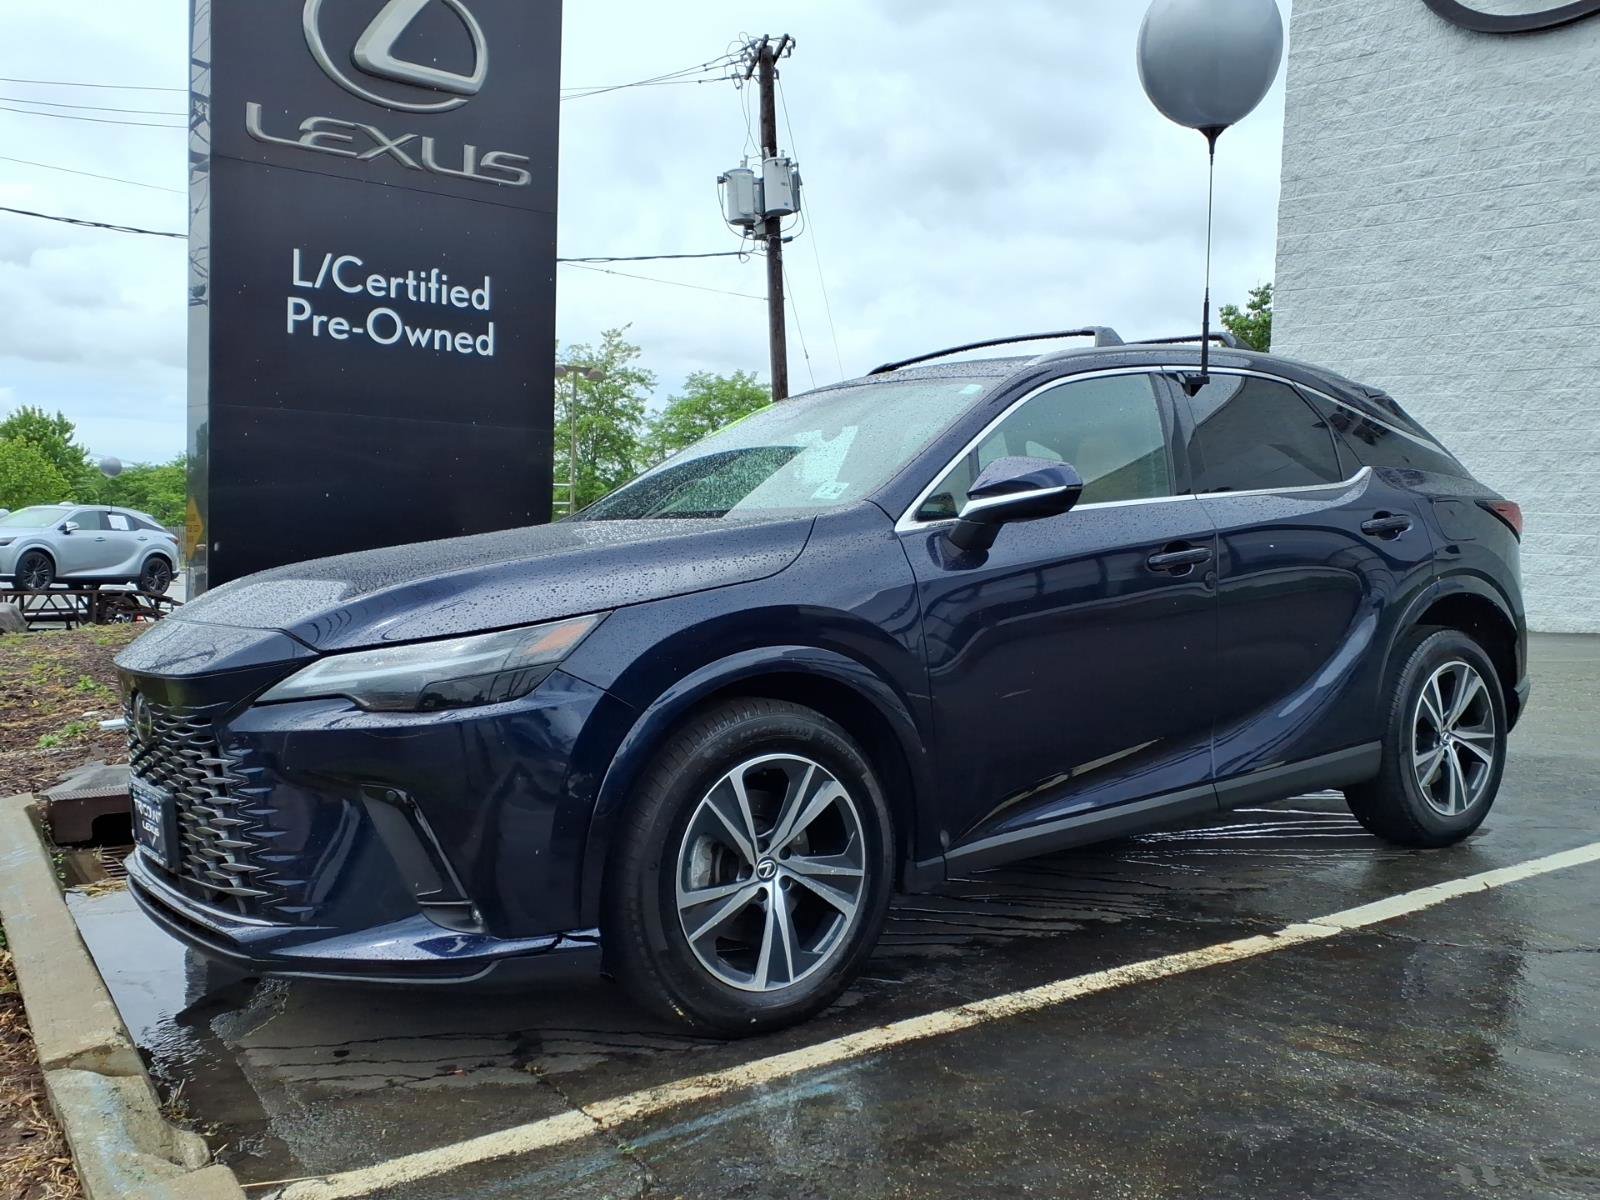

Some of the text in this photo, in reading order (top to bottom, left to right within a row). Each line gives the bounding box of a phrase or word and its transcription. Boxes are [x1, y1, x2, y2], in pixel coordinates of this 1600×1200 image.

[245, 102, 532, 185] LEXUS
[293, 248, 491, 311] L/Certified
[286, 296, 495, 357] Pre-Owned
